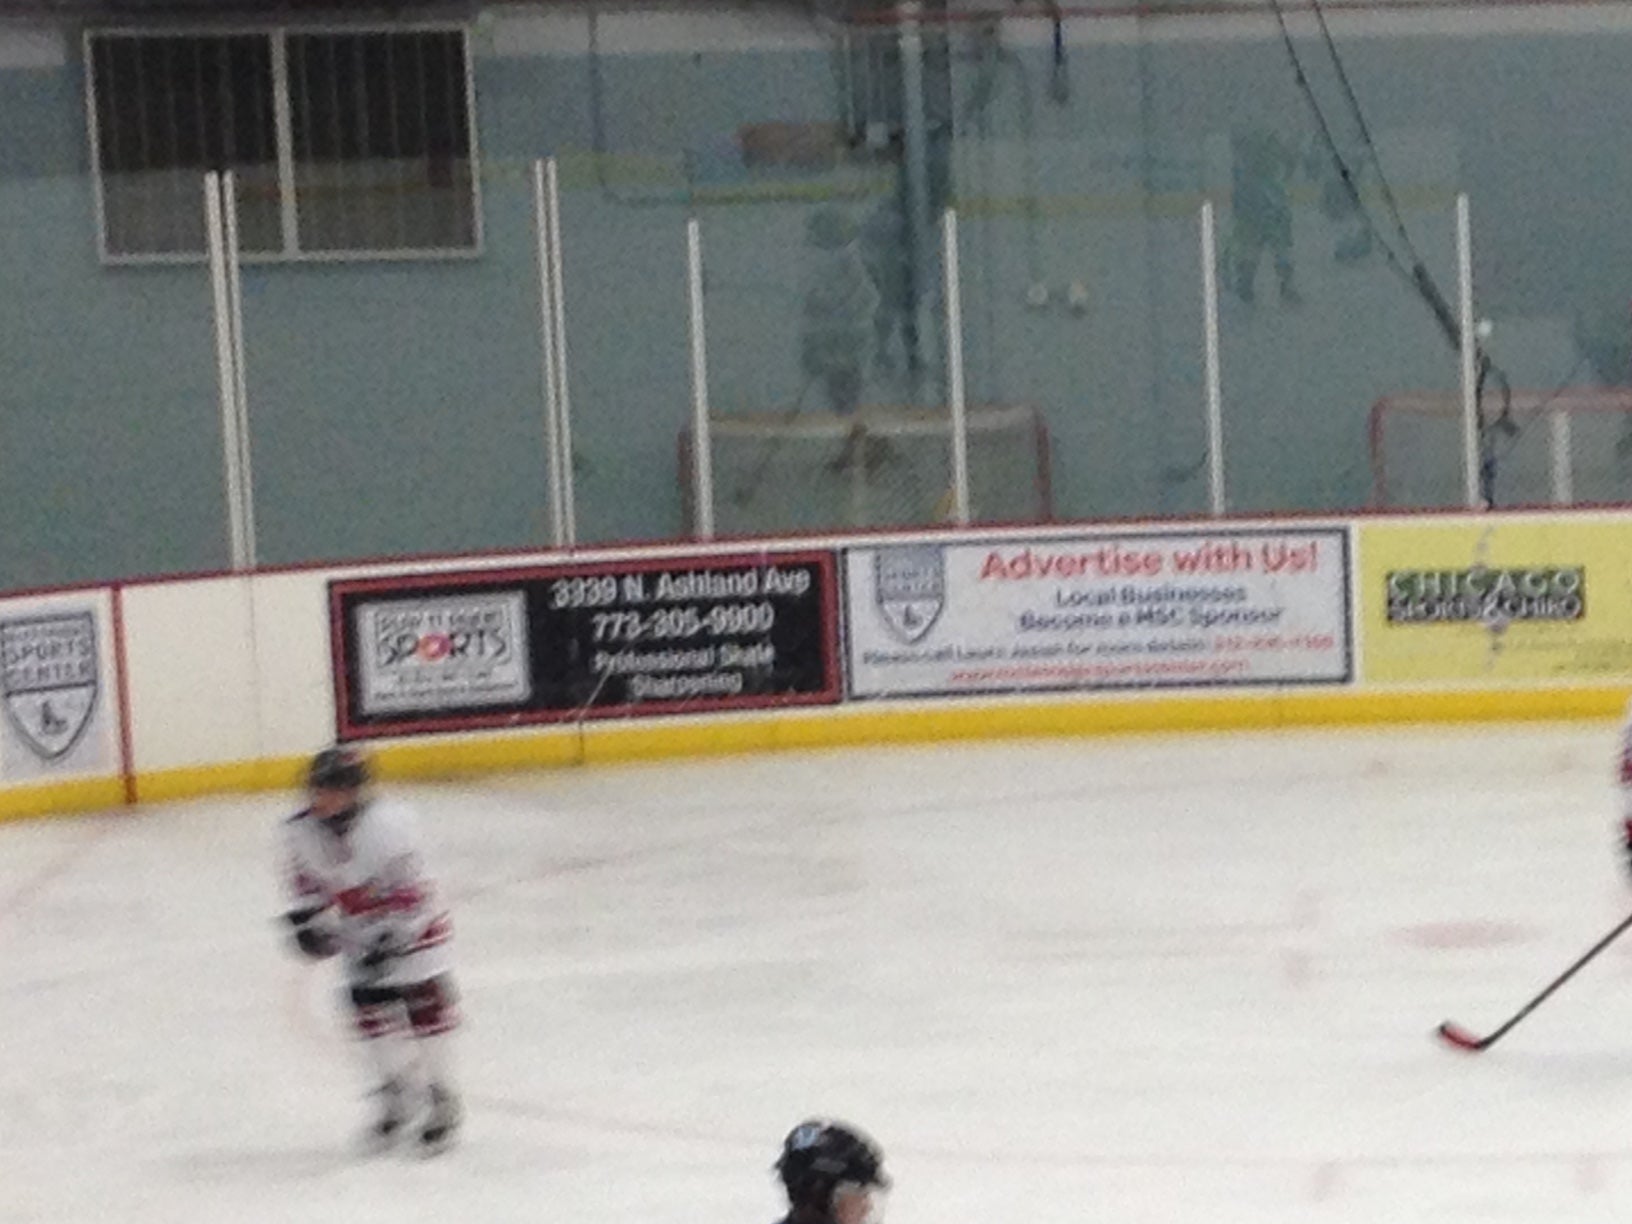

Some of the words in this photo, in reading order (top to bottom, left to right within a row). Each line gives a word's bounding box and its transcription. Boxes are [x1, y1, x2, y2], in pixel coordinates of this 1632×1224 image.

[981, 546, 1161, 580] Advertise
[1173, 540, 1252, 573] with
[1261, 540, 1320, 574] Us!
[550, 575, 617, 610] 3939
[656, 569, 759, 600] Ashland
[763, 565, 811, 598] Ave
[1056, 586, 1116, 607] Local
[1120, 582, 1247, 605] Businesses
[1390, 568, 1580, 600] CHICAGO
[1188, 604, 1285, 629] Sponsor
[6, 637, 92, 665] SPORTS
[378, 628, 507, 669] SPORTS
